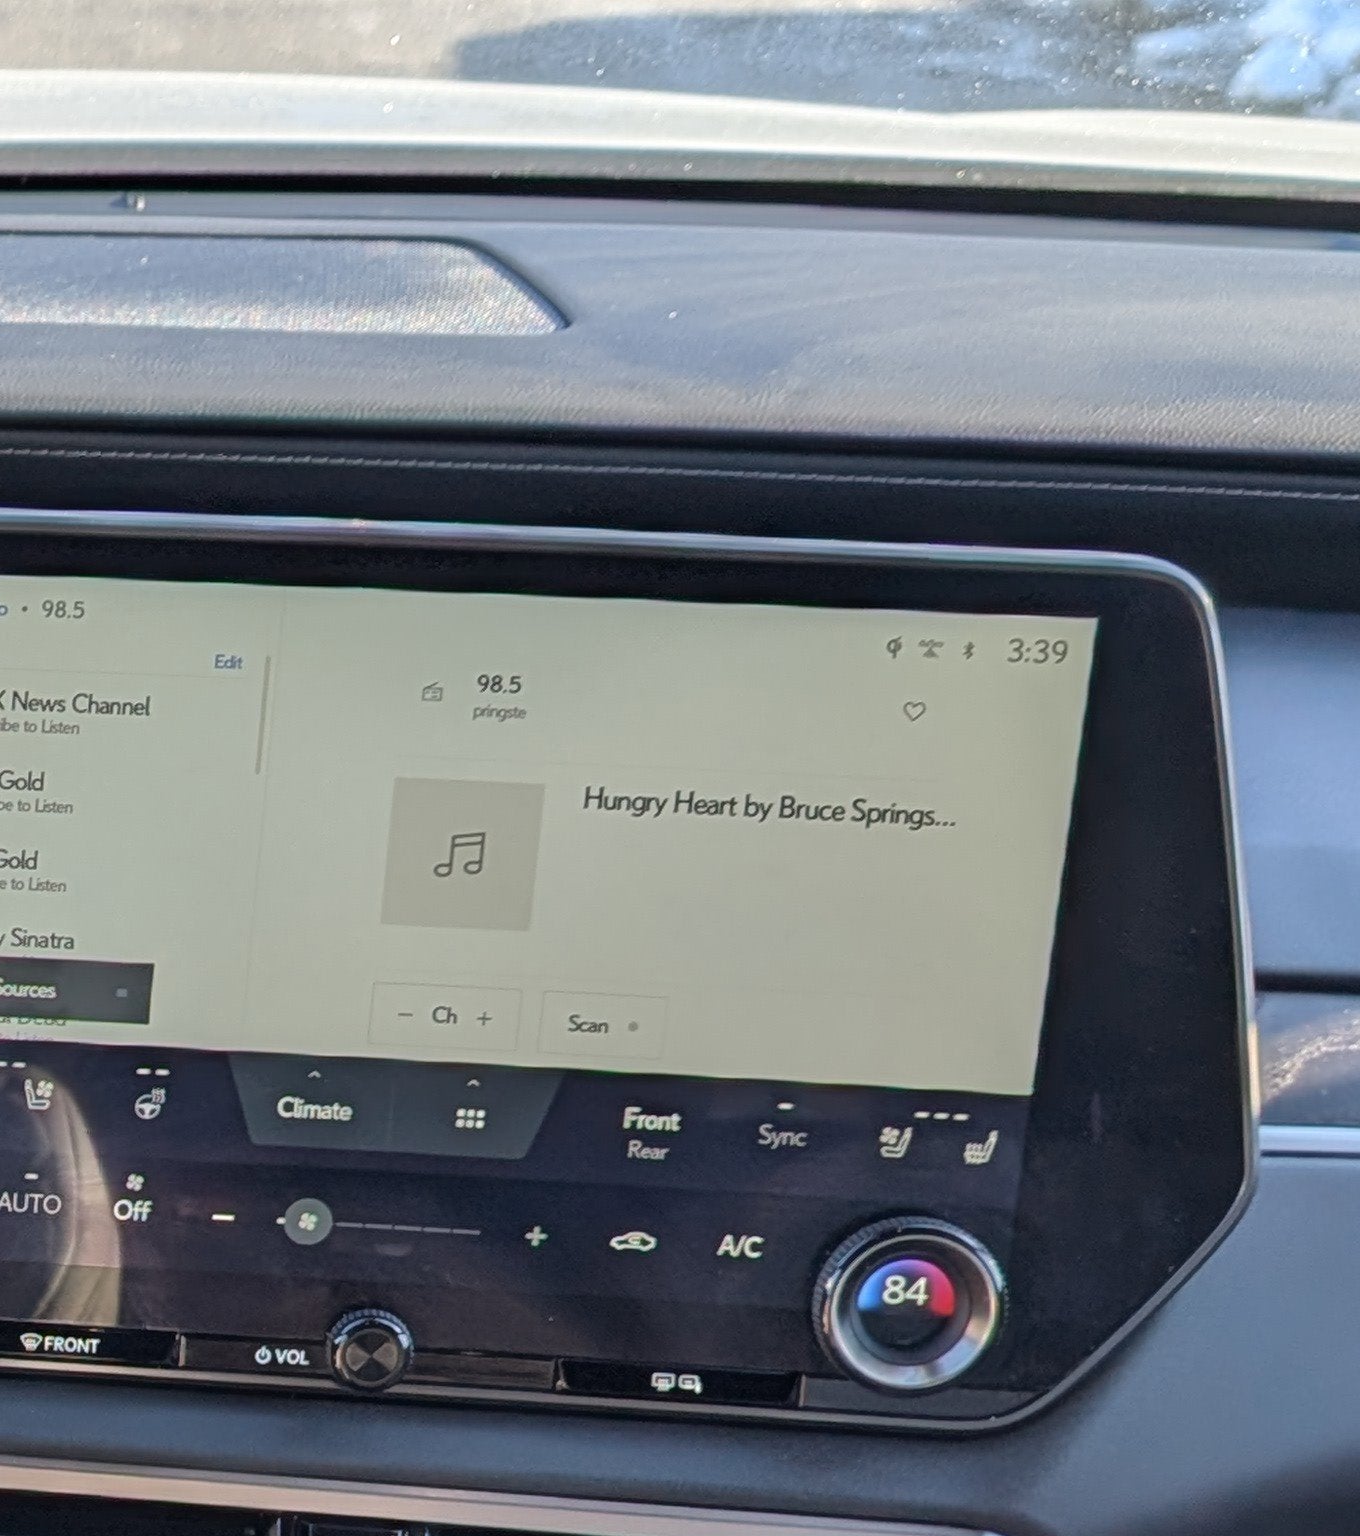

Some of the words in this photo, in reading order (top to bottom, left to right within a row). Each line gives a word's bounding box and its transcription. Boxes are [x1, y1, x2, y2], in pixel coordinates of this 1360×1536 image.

[41, 599, 85, 620] 98.5
[214, 653, 244, 670] Edit
[1006, 638, 1069, 665] 3:39
[477, 674, 522, 695] 98.5
[11, 690, 66, 713] News
[71, 692, 151, 717] Channel
[23, 720, 38, 734] to
[40, 718, 80, 735] Listen
[16, 799, 32, 813] to
[34, 797, 74, 814] Listen
[582, 785, 669, 819] Hungry
[672, 790, 738, 817] Heart
[743, 793, 774, 823] by
[778, 795, 846, 822] Bruce
[850, 798, 956, 831] Springs...
[10, 878, 25, 891] to
[27, 876, 67, 893] Listen
[10, 927, 75, 950] Sinatra
[431, 1005, 458, 1025] Ch
[567, 1014, 609, 1034] Scan
[276, 1095, 353, 1122] Climate
[622, 1106, 682, 1132] Front
[757, 1123, 808, 1150] Sync
[626, 1139, 670, 1160] Rear
[112, 1198, 153, 1223] Off
[716, 1234, 765, 1259] A/C
[881, 1274, 929, 1306] 84
[43, 1335, 102, 1355] FRONT
[274, 1348, 310, 1366] VOL
